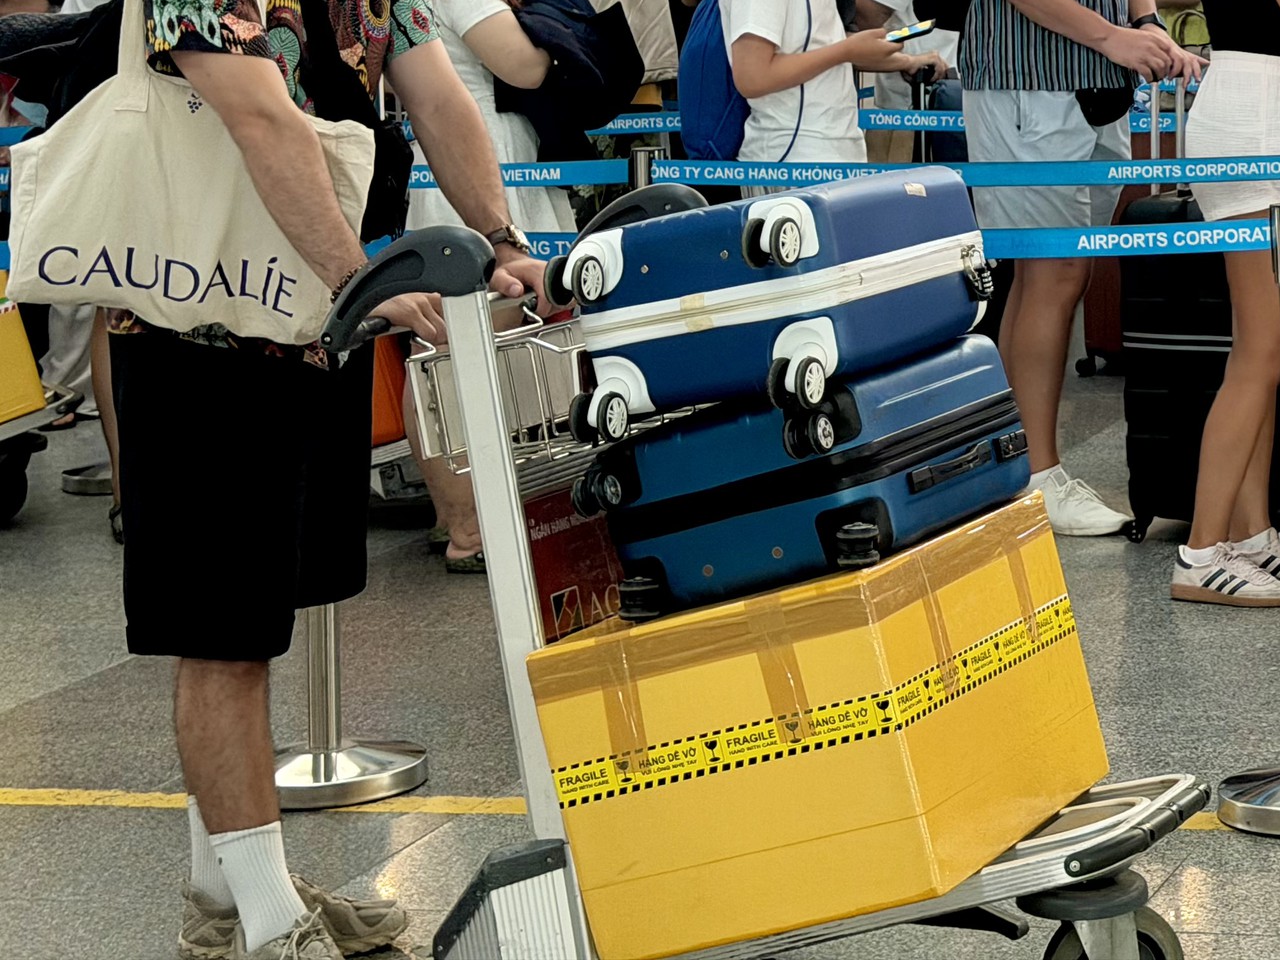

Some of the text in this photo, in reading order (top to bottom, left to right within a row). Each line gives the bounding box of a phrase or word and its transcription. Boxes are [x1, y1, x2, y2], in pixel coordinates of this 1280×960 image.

[606, 117, 663, 129] AIRPORTS
[940, 116, 956, 127] TY
[502, 168, 560, 182] VIETNAM
[684, 167, 701, 179] TY
[1108, 165, 1182, 179] AIRPORTS
[1077, 225, 1271, 250] AIRPORTS CORPORAT
[559, 768, 608, 788] FRAGILE
[726, 729, 776, 748] FRAGILE
[808, 713, 836, 729] HÀNG
[897, 687, 920, 707] FRAGILE
[971, 648, 992, 666] FRAGILE
